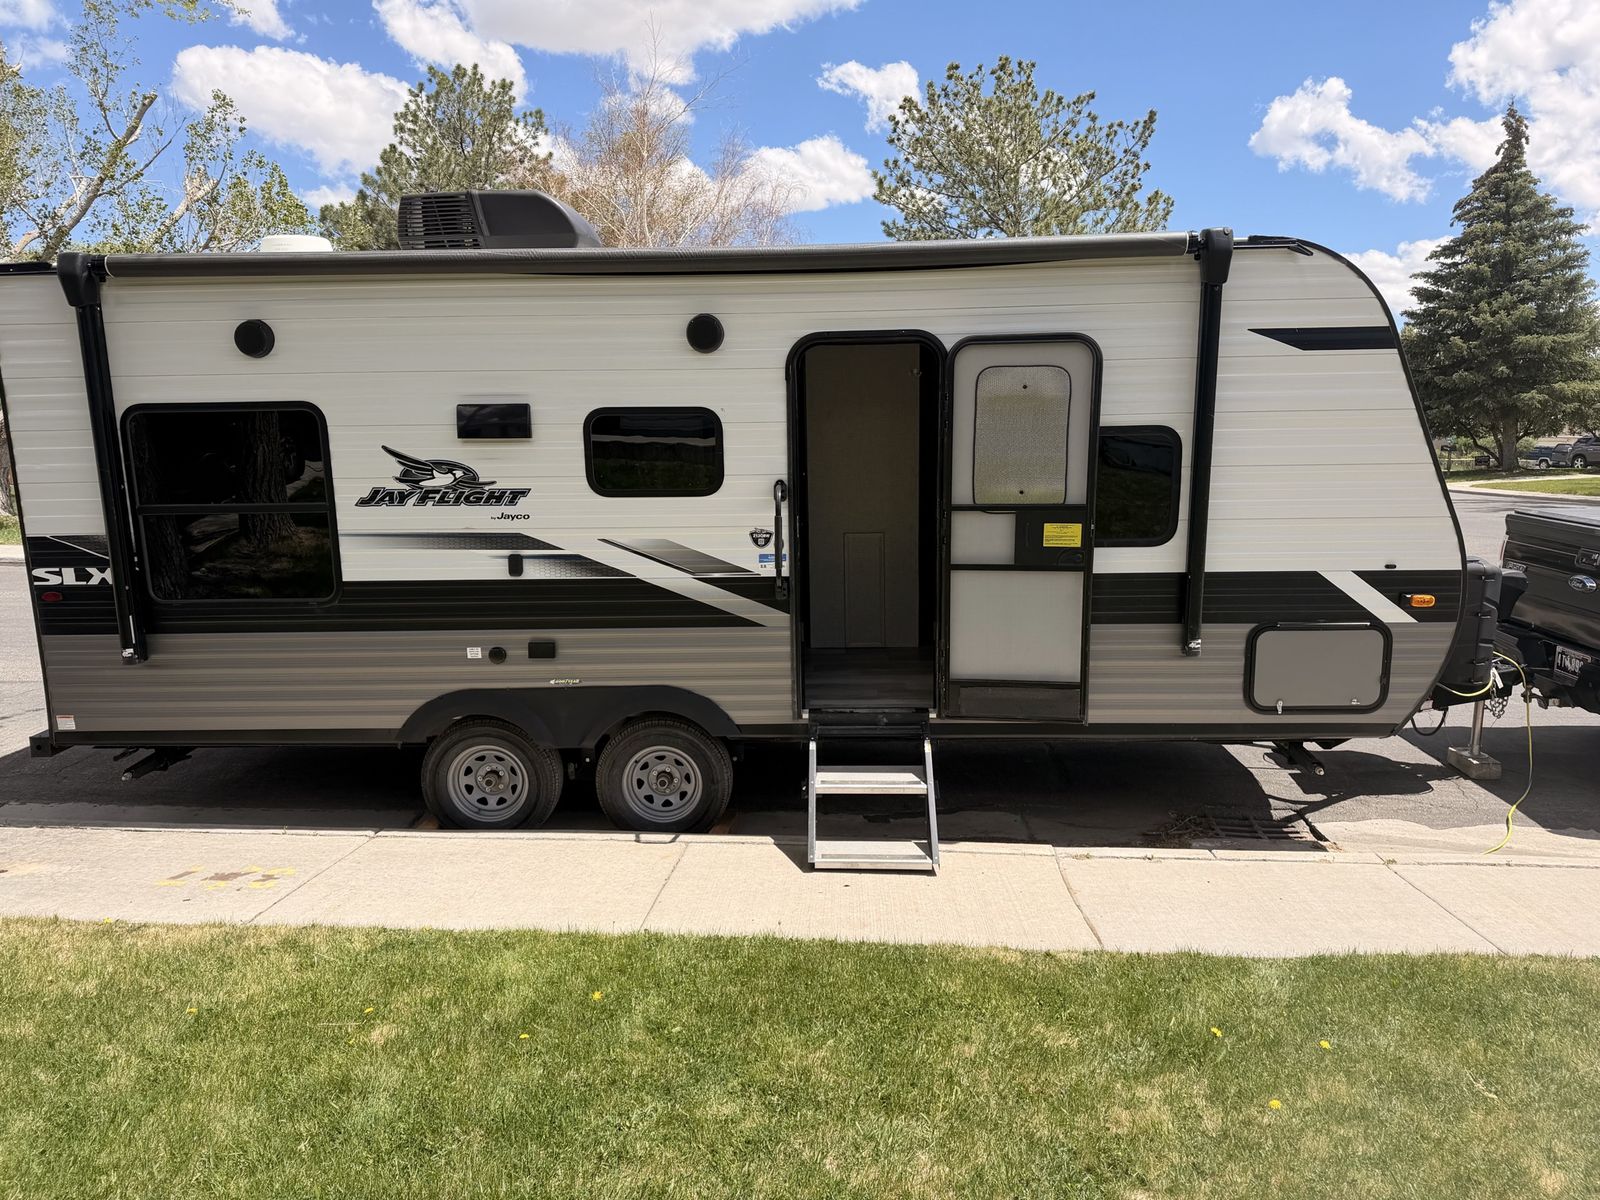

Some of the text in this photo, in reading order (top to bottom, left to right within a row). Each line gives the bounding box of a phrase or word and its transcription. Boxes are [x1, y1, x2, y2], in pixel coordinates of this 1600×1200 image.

[355, 487, 532, 507] JAY FLIGHT
[497, 512, 531, 521] Jayco
[31, 567, 113, 586] SLX
